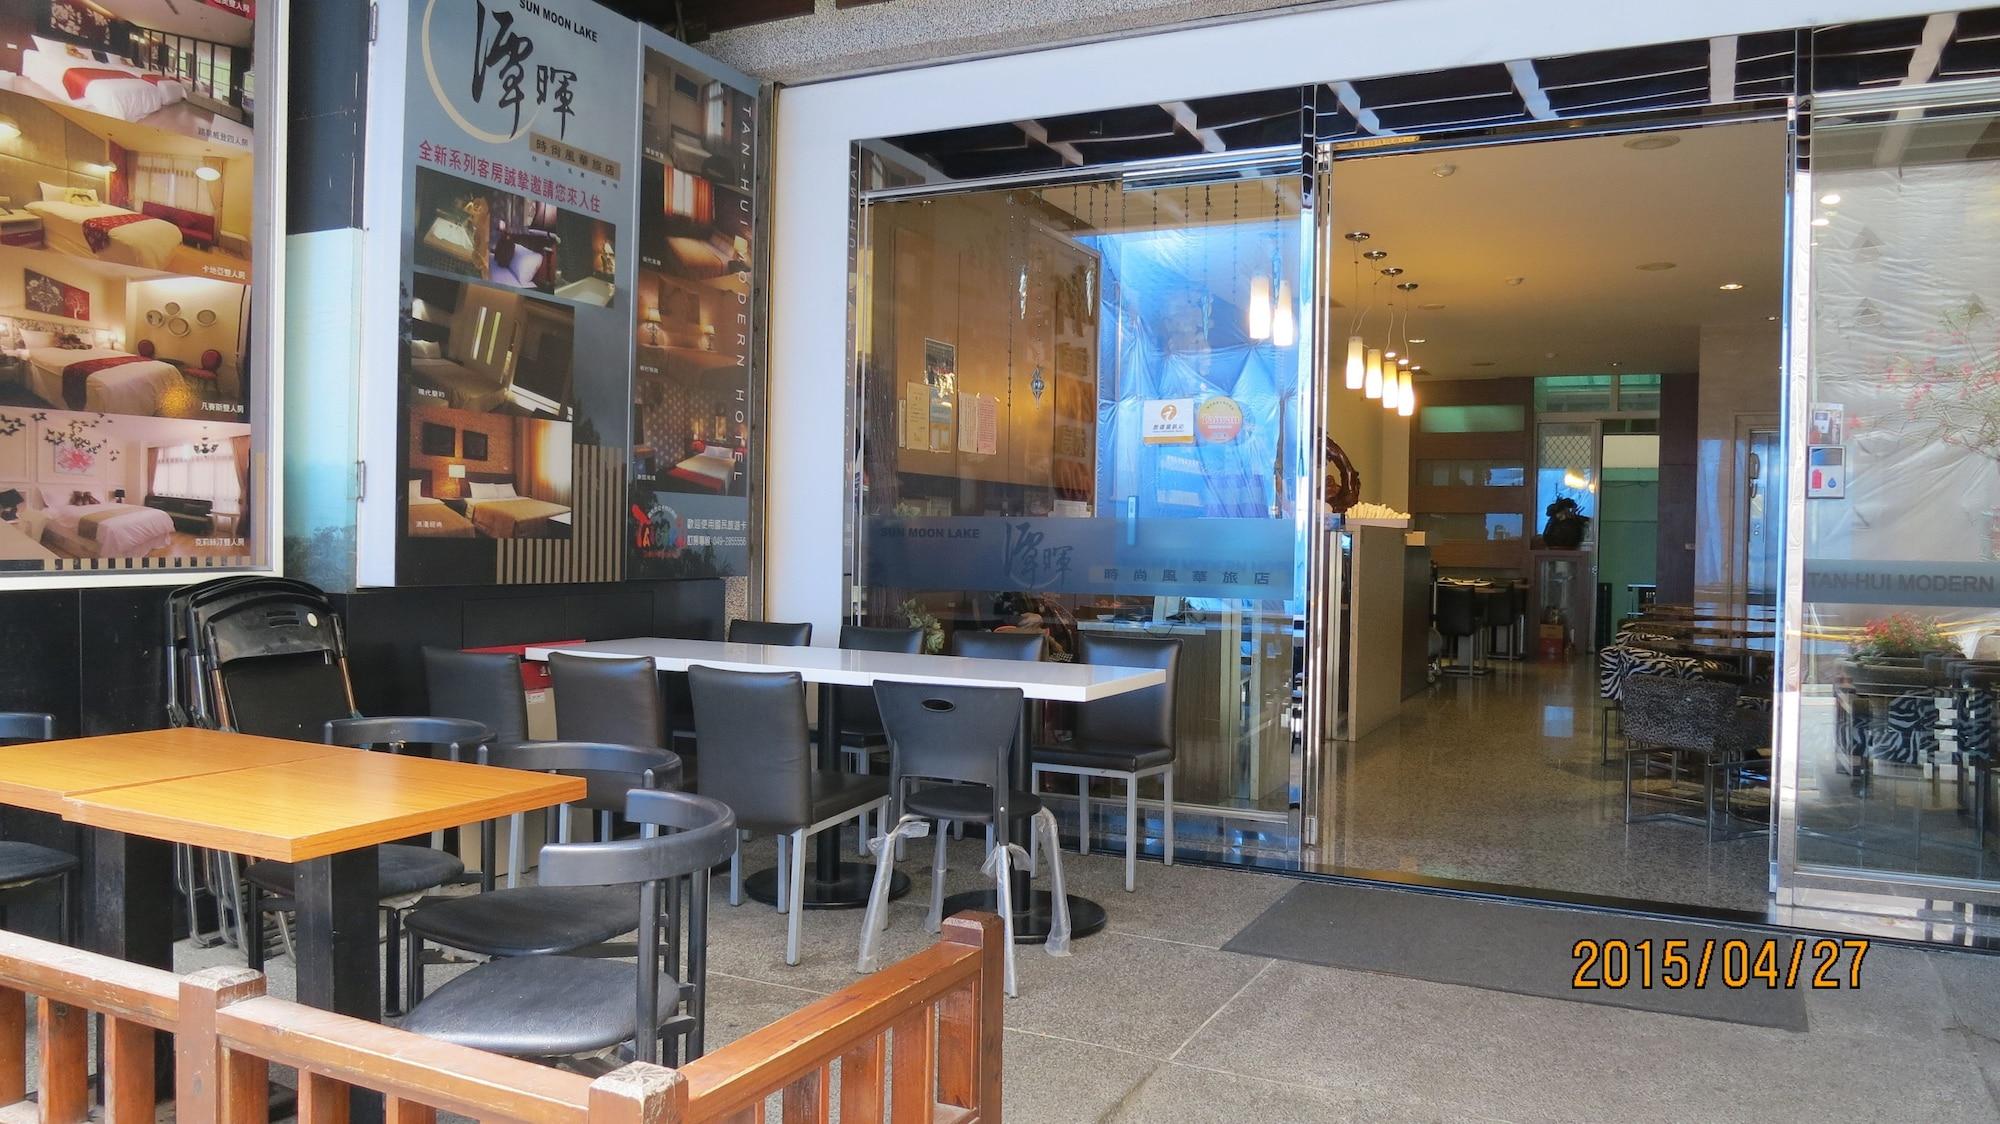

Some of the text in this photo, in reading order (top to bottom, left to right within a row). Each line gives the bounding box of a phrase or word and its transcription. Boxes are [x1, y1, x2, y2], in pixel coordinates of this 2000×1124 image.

[520, 0, 598, 43] SUN MOON LAKE
[739, 106, 752, 226] TAN-HUI
[733, 389, 745, 481] HOTEL
[880, 527, 980, 539] SUN MOON LAKE
[1103, 568, 1270, 585] 時尚風華旅店
[1807, 572, 1994, 592] TAN-HUI MODERN
